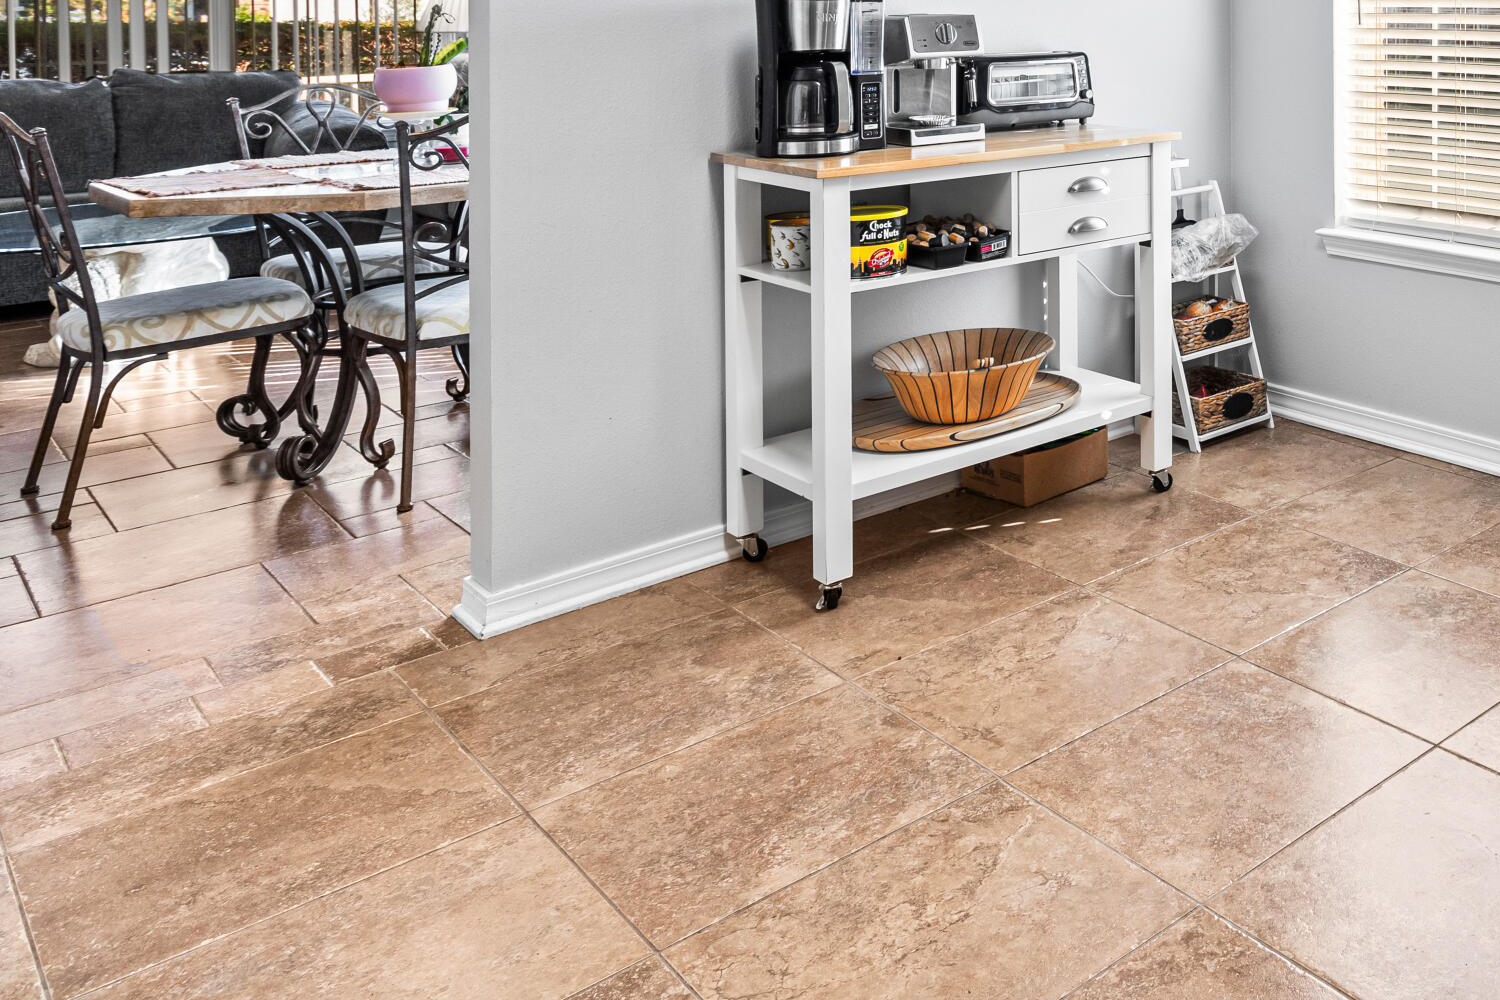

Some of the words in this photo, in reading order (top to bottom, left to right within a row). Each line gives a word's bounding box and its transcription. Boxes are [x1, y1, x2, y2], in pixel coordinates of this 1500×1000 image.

[870, 220, 892, 231] Chock
[860, 230, 876, 242] full
[883, 229, 899, 239] Nuts
